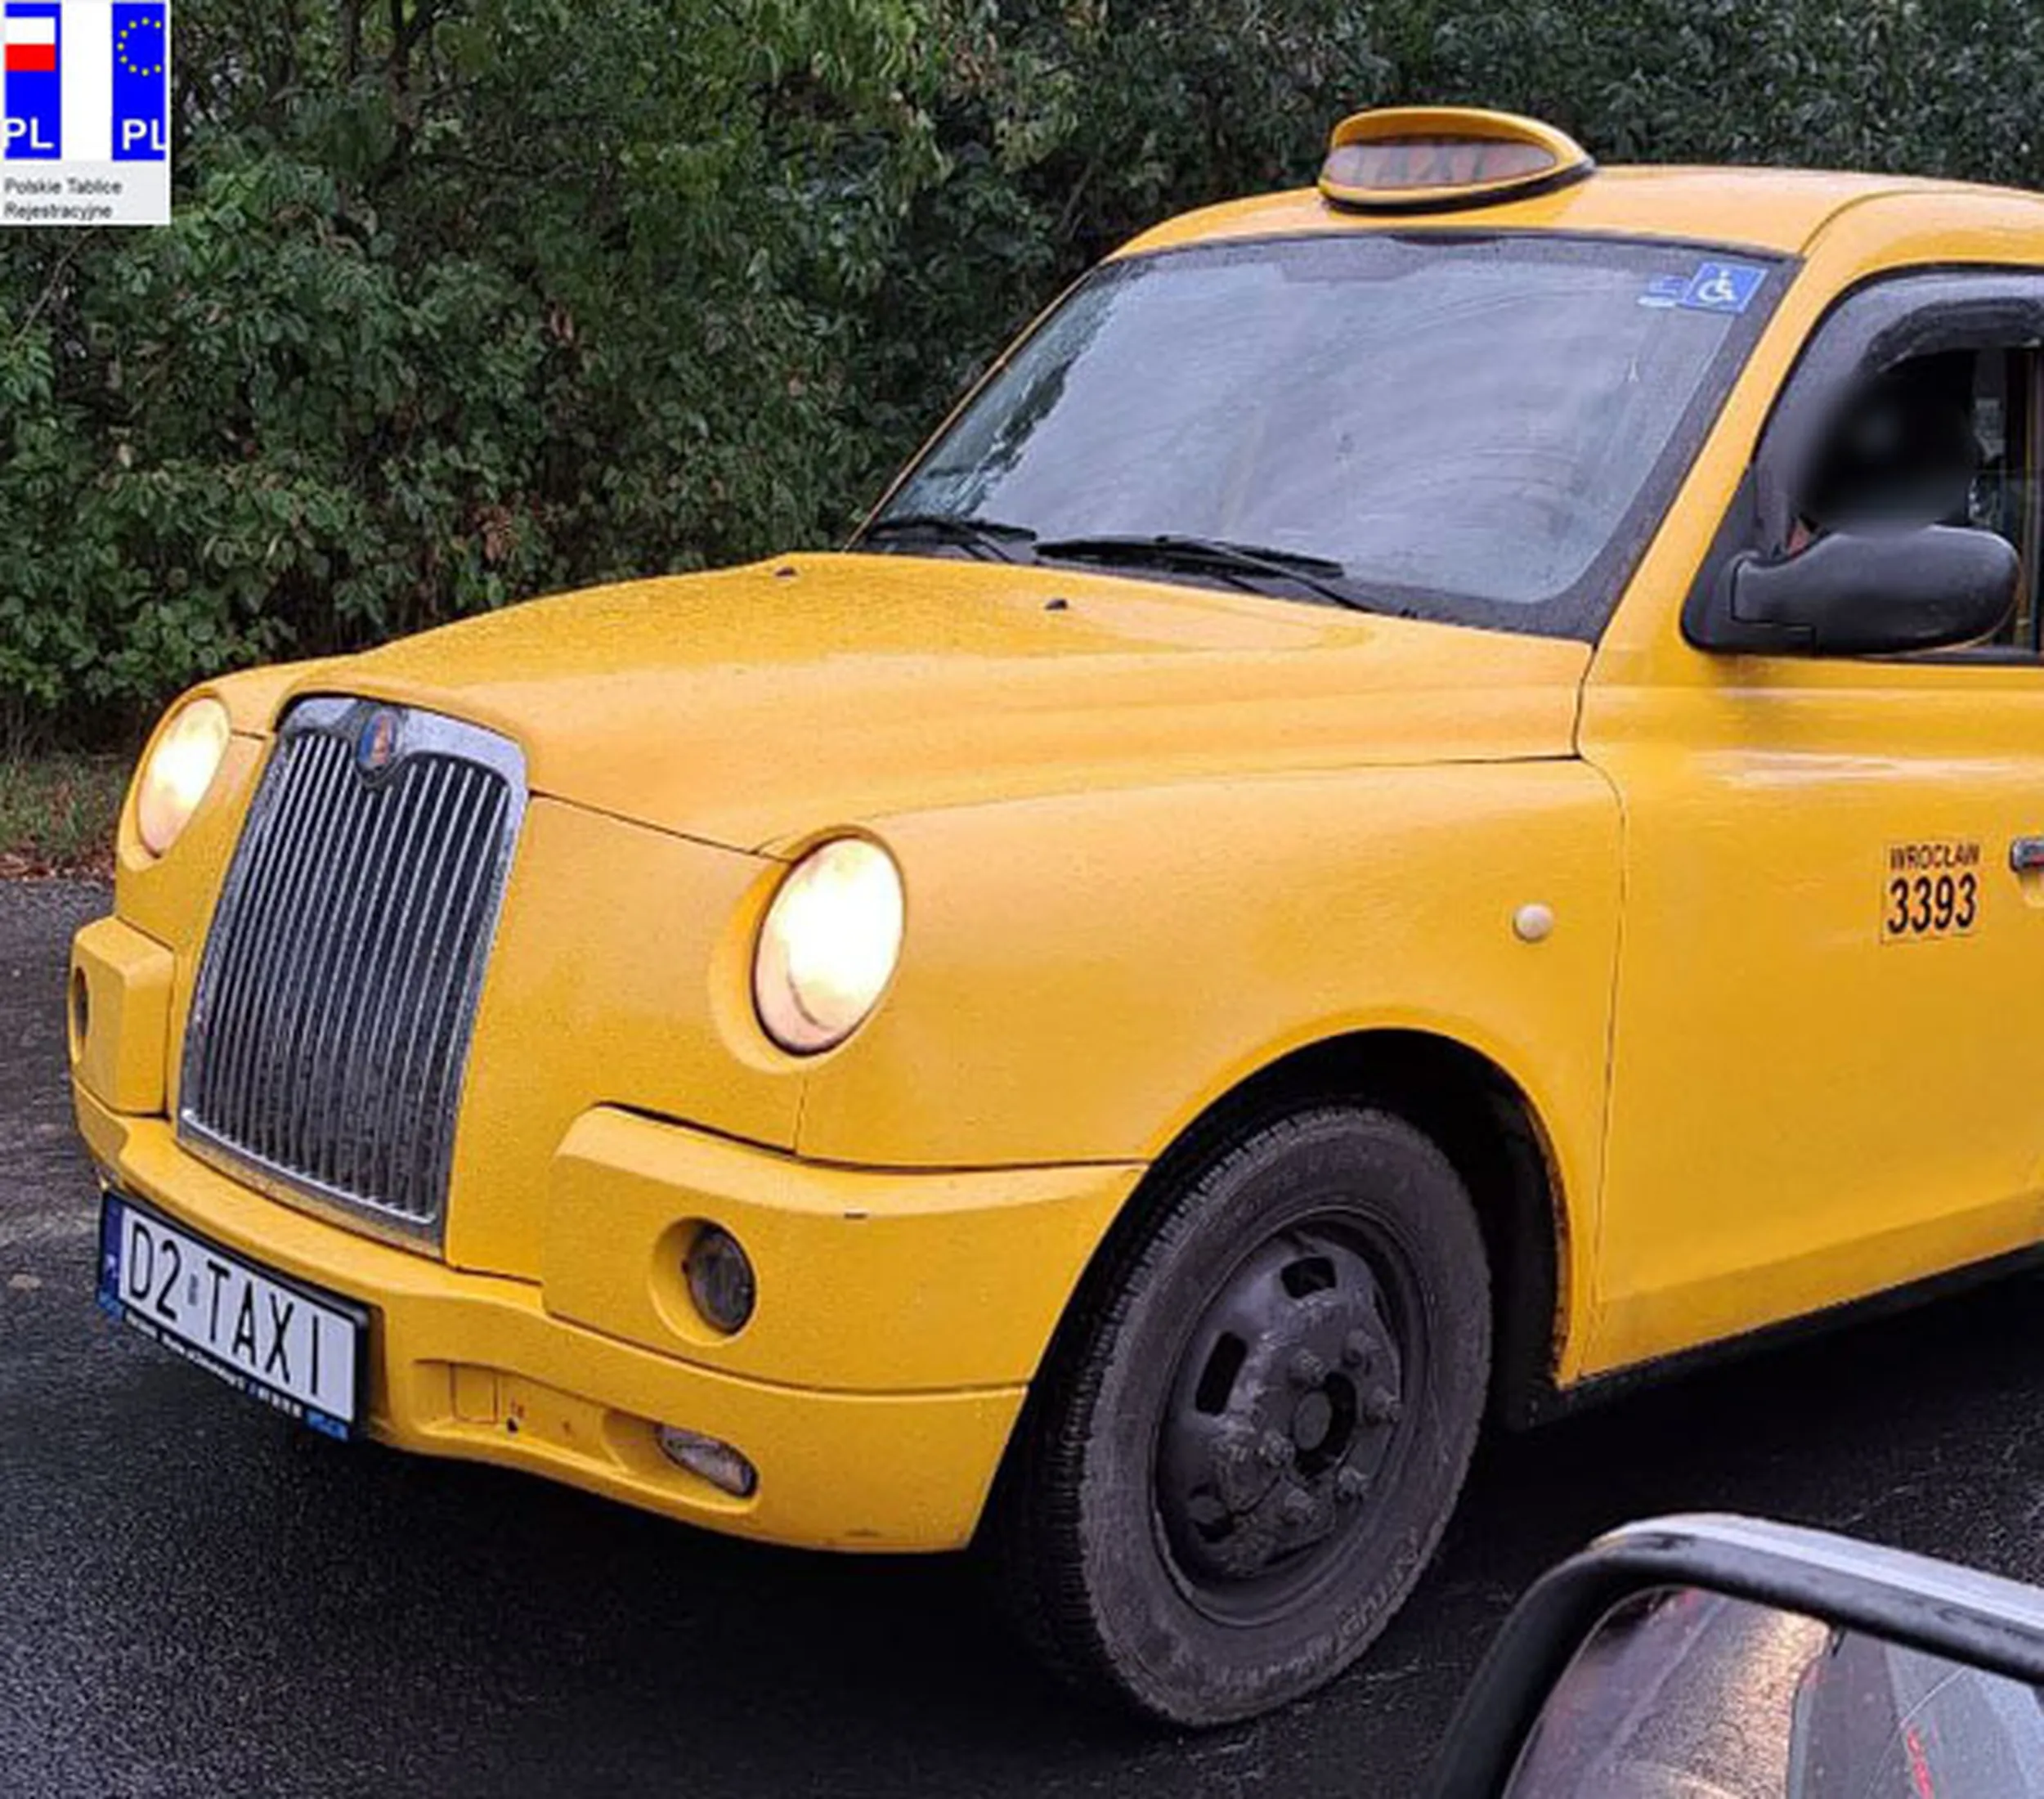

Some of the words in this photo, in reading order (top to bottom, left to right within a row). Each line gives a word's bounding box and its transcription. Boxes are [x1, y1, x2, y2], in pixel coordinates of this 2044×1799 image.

[1887, 873, 1977, 934] 3393
[128, 1221, 182, 1322] D2
[206, 1258, 320, 1397] TAXI
